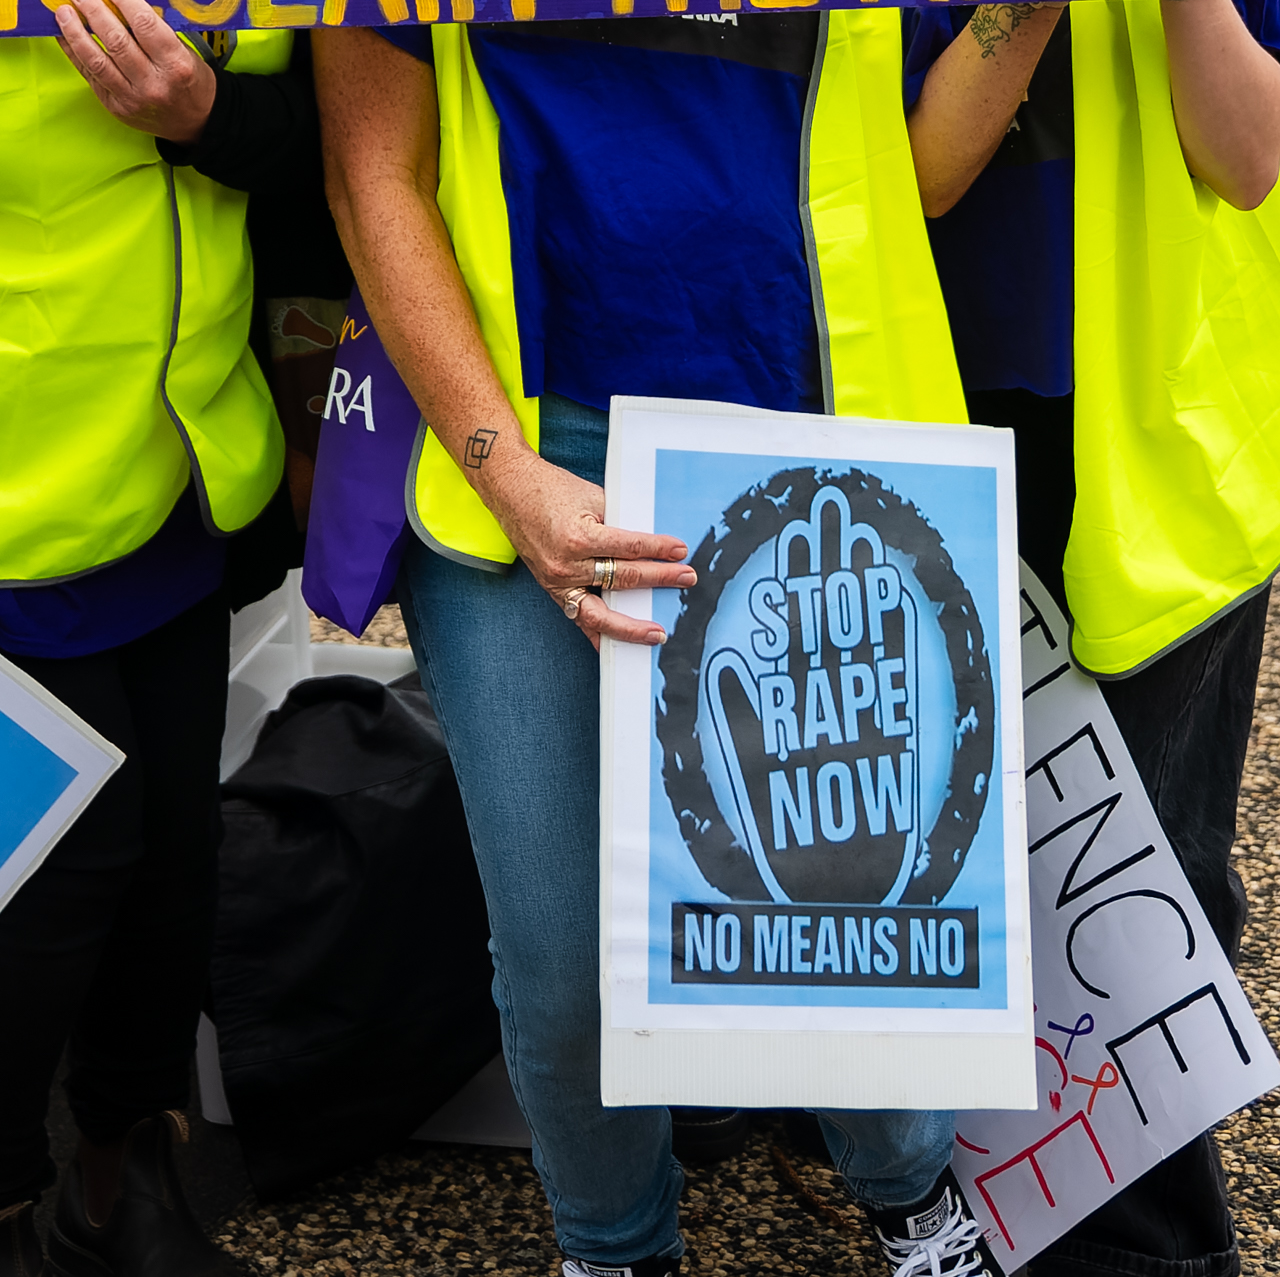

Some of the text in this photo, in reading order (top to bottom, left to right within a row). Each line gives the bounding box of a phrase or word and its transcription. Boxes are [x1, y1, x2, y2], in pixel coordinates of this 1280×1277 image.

[749, 562, 903, 664] STOP
[757, 657, 912, 758] RAPE
[768, 750, 914, 852] NOW
[1020, 588, 1252, 1126] ENCE
[684, 914, 966, 977] NO MEANS NO
